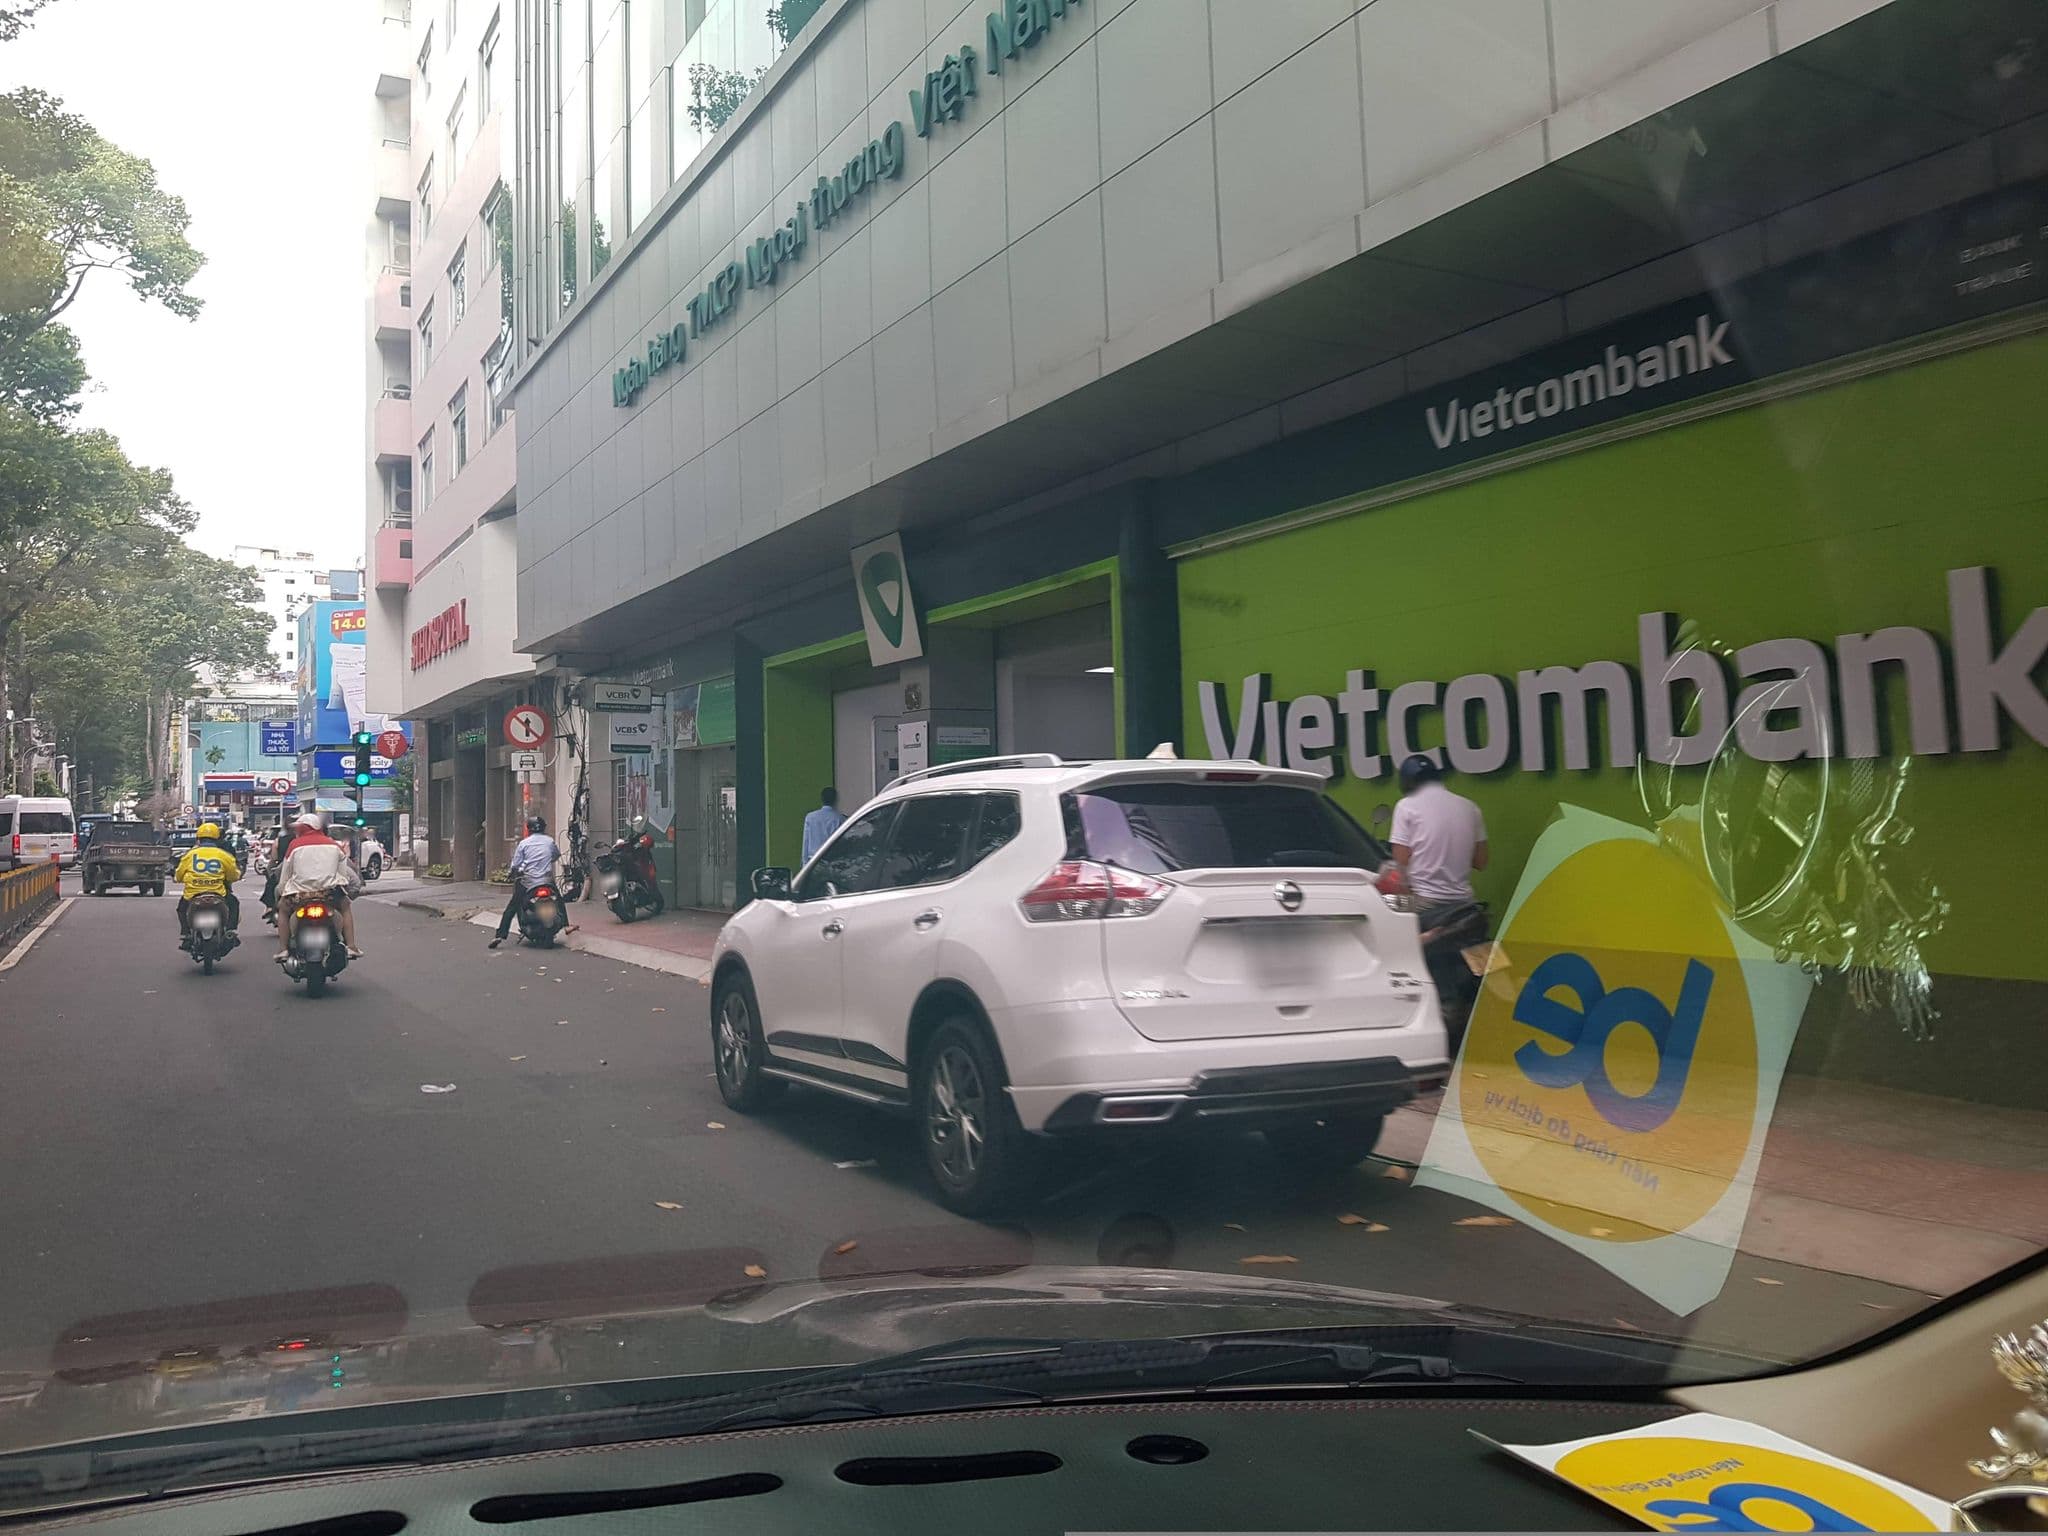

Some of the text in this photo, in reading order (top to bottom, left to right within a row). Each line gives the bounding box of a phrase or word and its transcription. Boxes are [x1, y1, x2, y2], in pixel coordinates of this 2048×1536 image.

[686, 261, 743, 339] TMCP
[908, 45, 977, 138] Việt
[1426, 313, 1736, 450] Vietcombank
[615, 726, 637, 734] VCBS
[1197, 565, 2048, 779] Vietcombank
[192, 853, 223, 874] be
